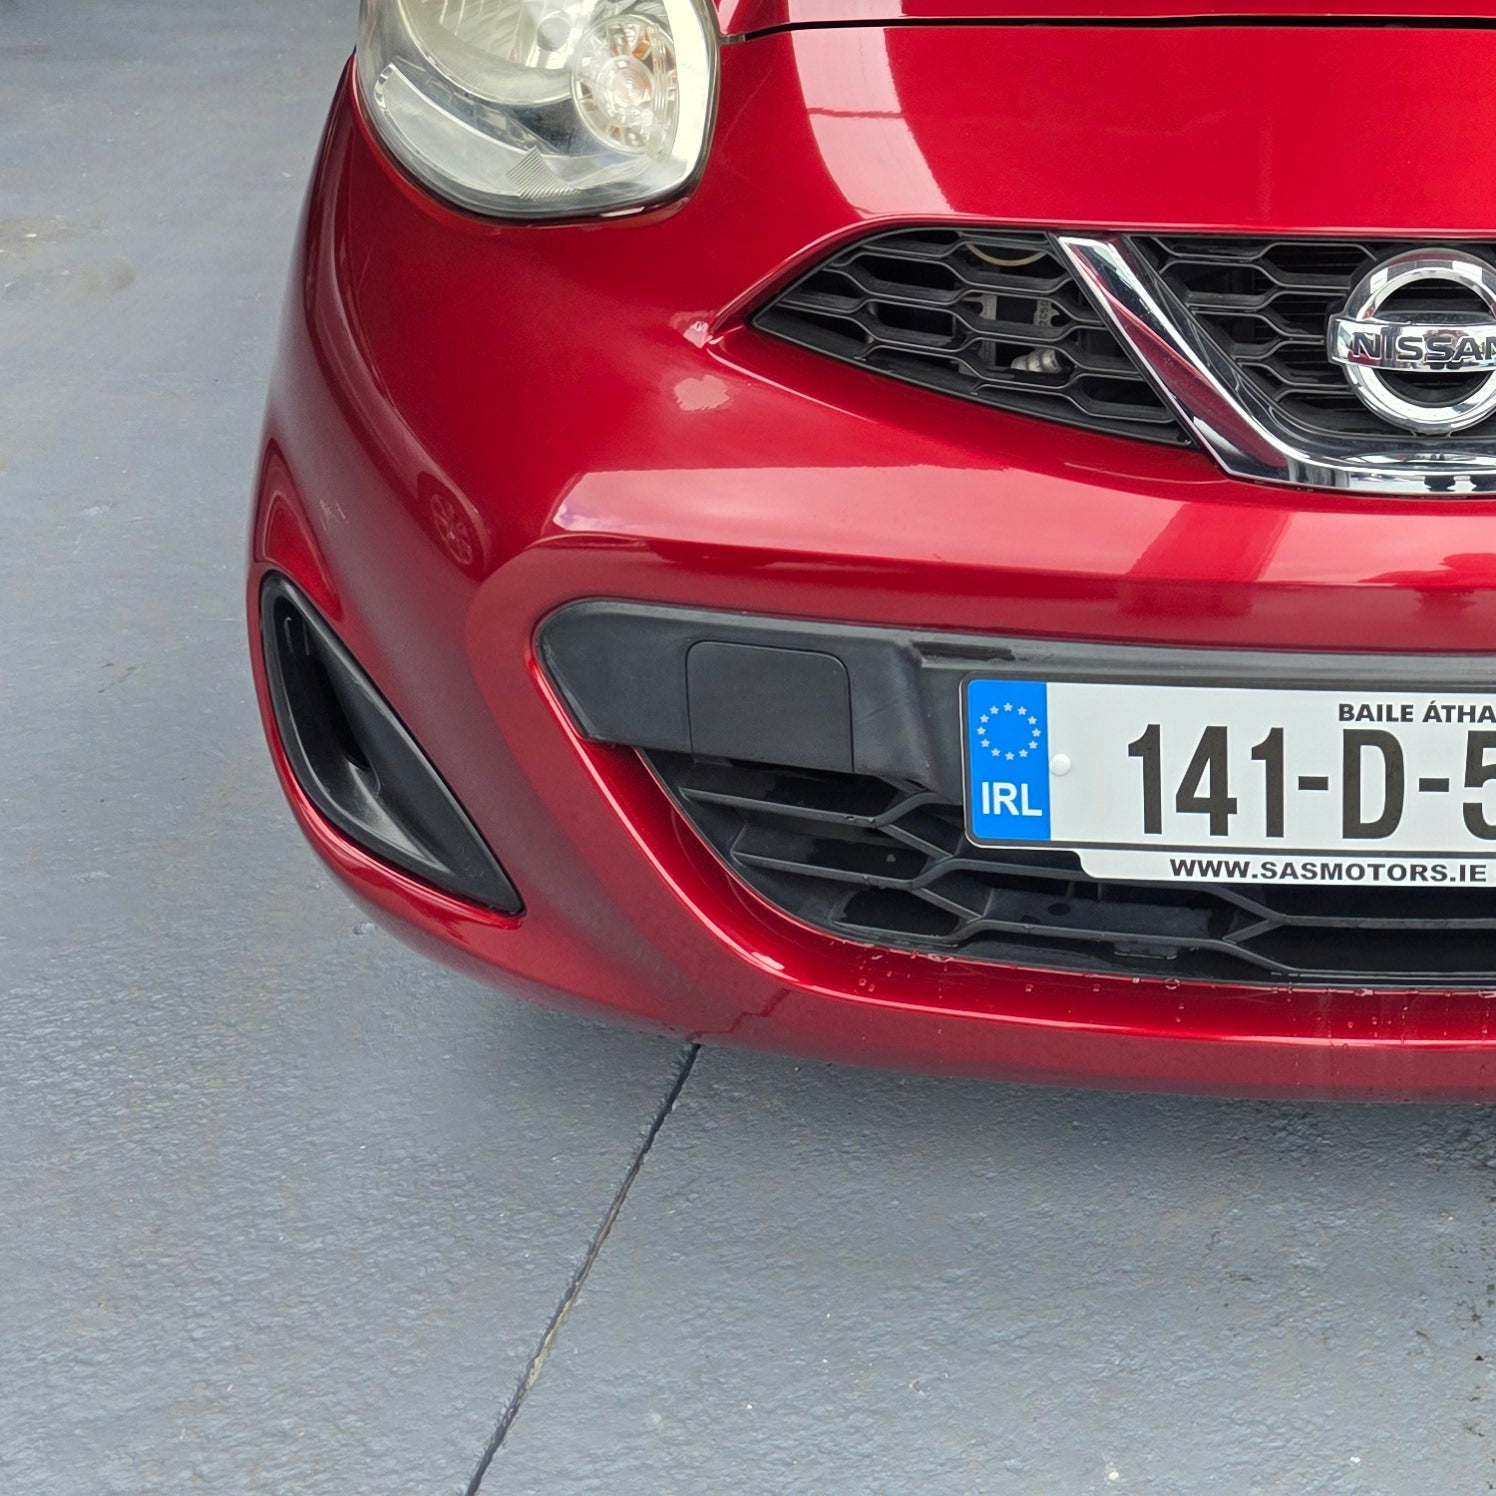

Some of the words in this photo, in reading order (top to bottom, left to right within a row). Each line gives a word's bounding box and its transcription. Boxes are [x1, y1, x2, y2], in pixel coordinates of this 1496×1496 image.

[1338, 703, 1414, 723] BAILE
[1422, 699, 1496, 724] ÁTHA
[981, 782, 1043, 816] IRL
[1169, 858, 1487, 883] WWW.SASMOTORS.IE
